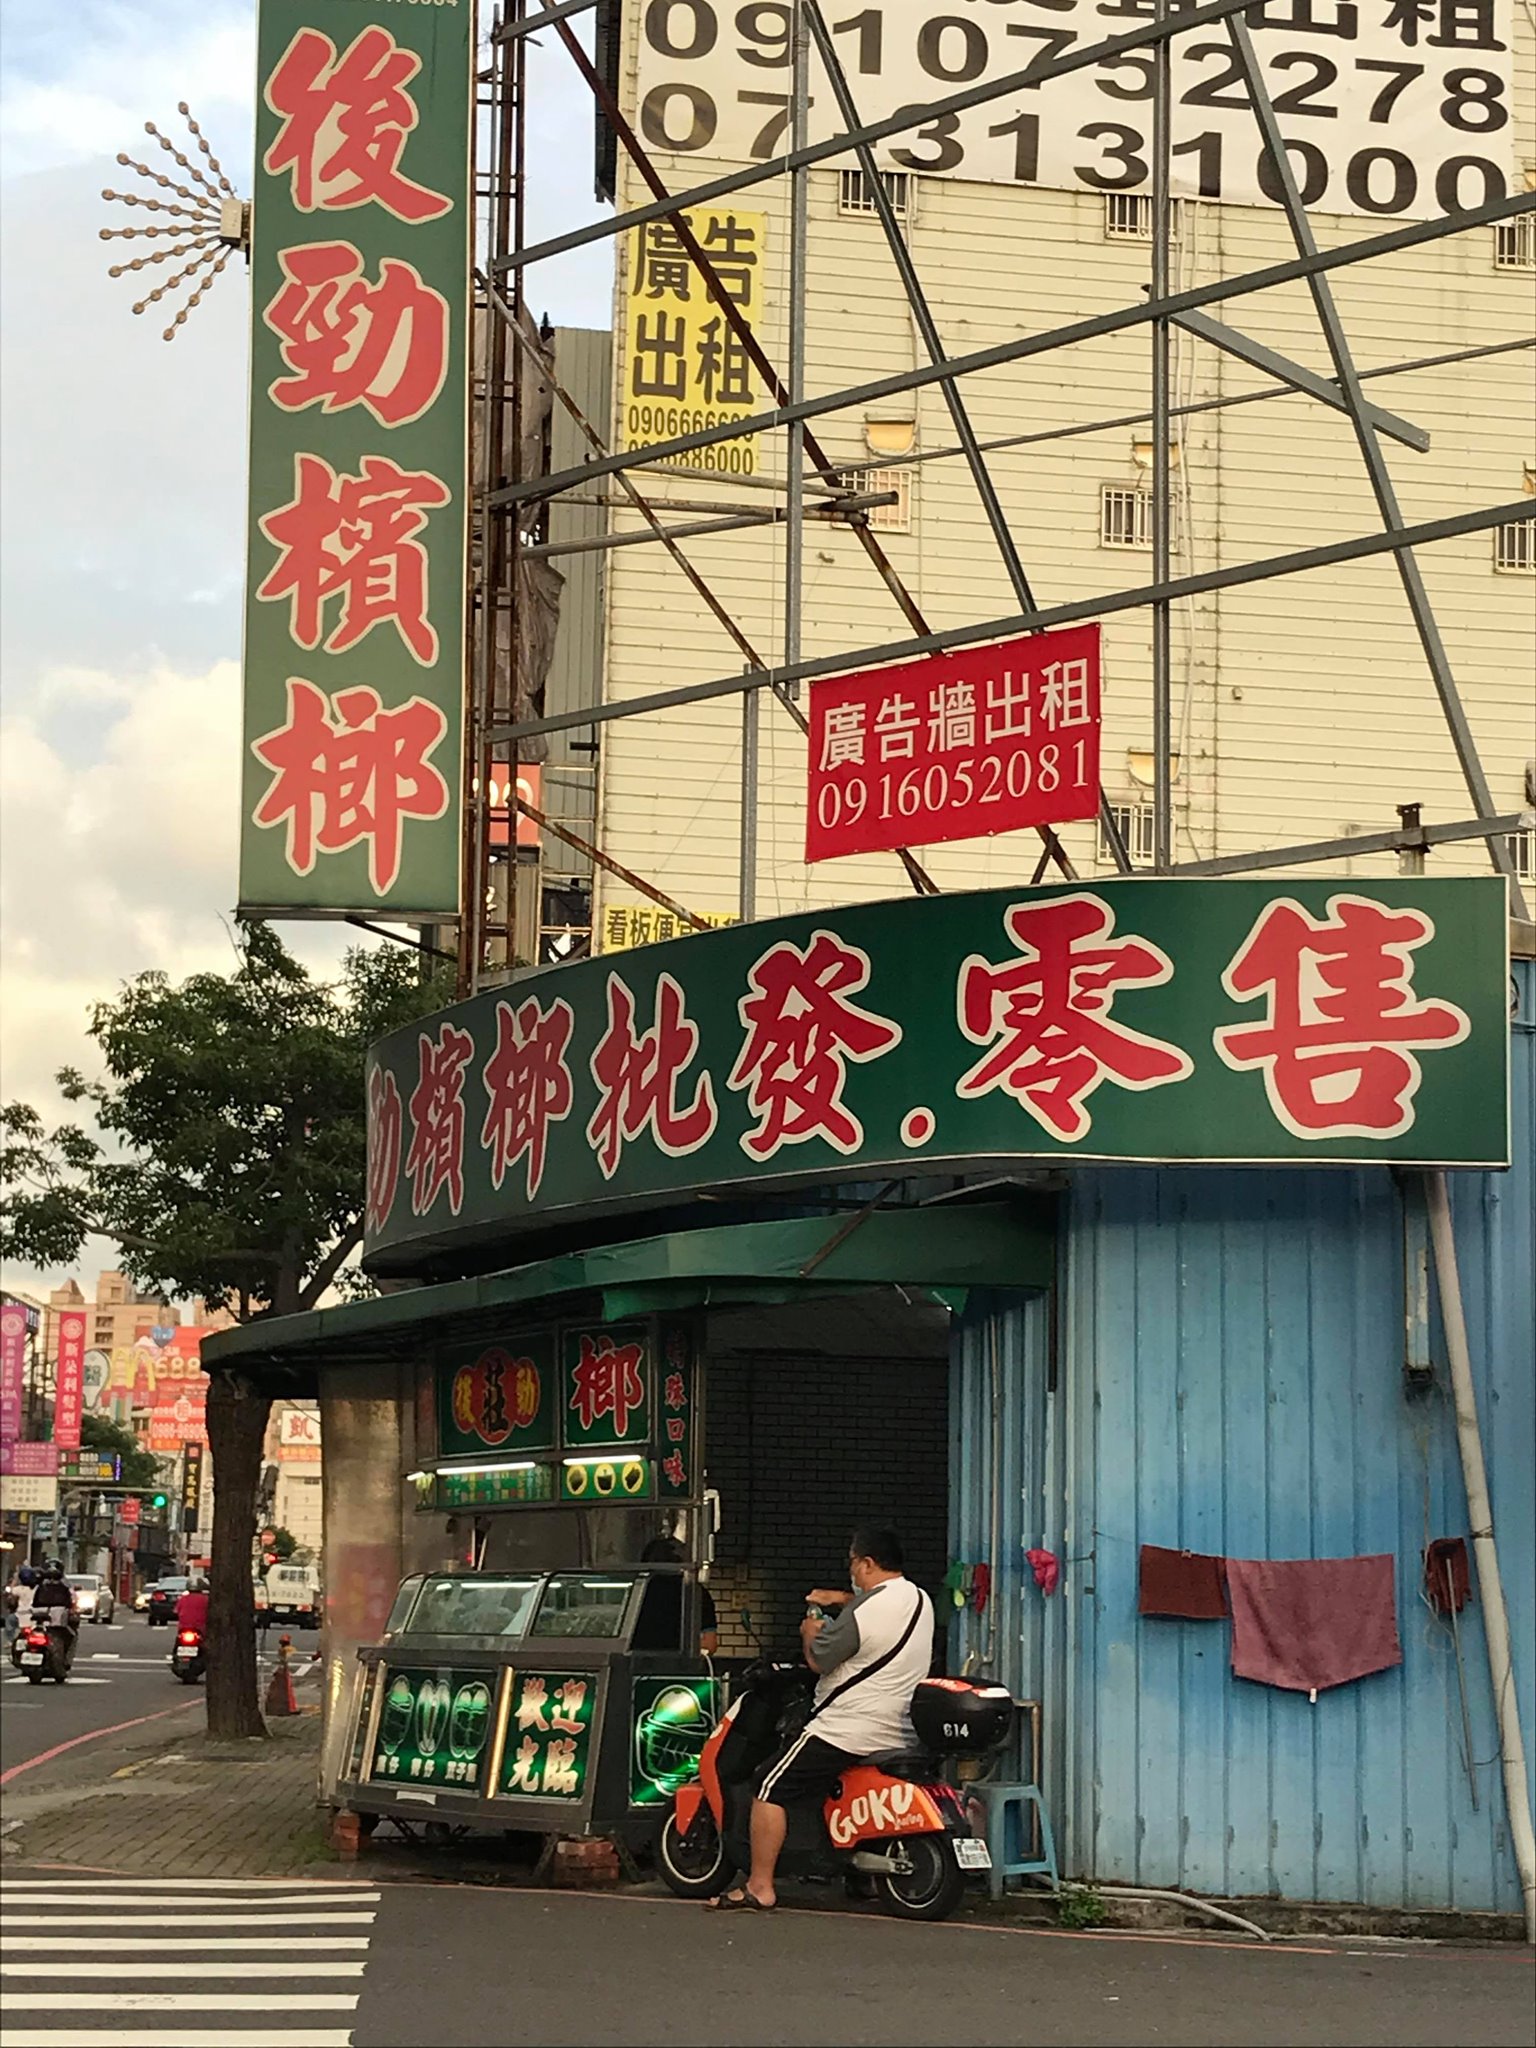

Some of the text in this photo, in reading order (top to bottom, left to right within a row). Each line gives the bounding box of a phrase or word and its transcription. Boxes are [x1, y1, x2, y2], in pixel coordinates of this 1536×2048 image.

[641, 84, 1507, 216] 073131000
[632, 214, 758, 307] 廣告
[631, 310, 754, 405] 出租
[251, 24, 455, 897] 後勁檳榔
[818, 739, 1089, 828] 0916052081
[508, 1735, 579, 1794] 光臨
